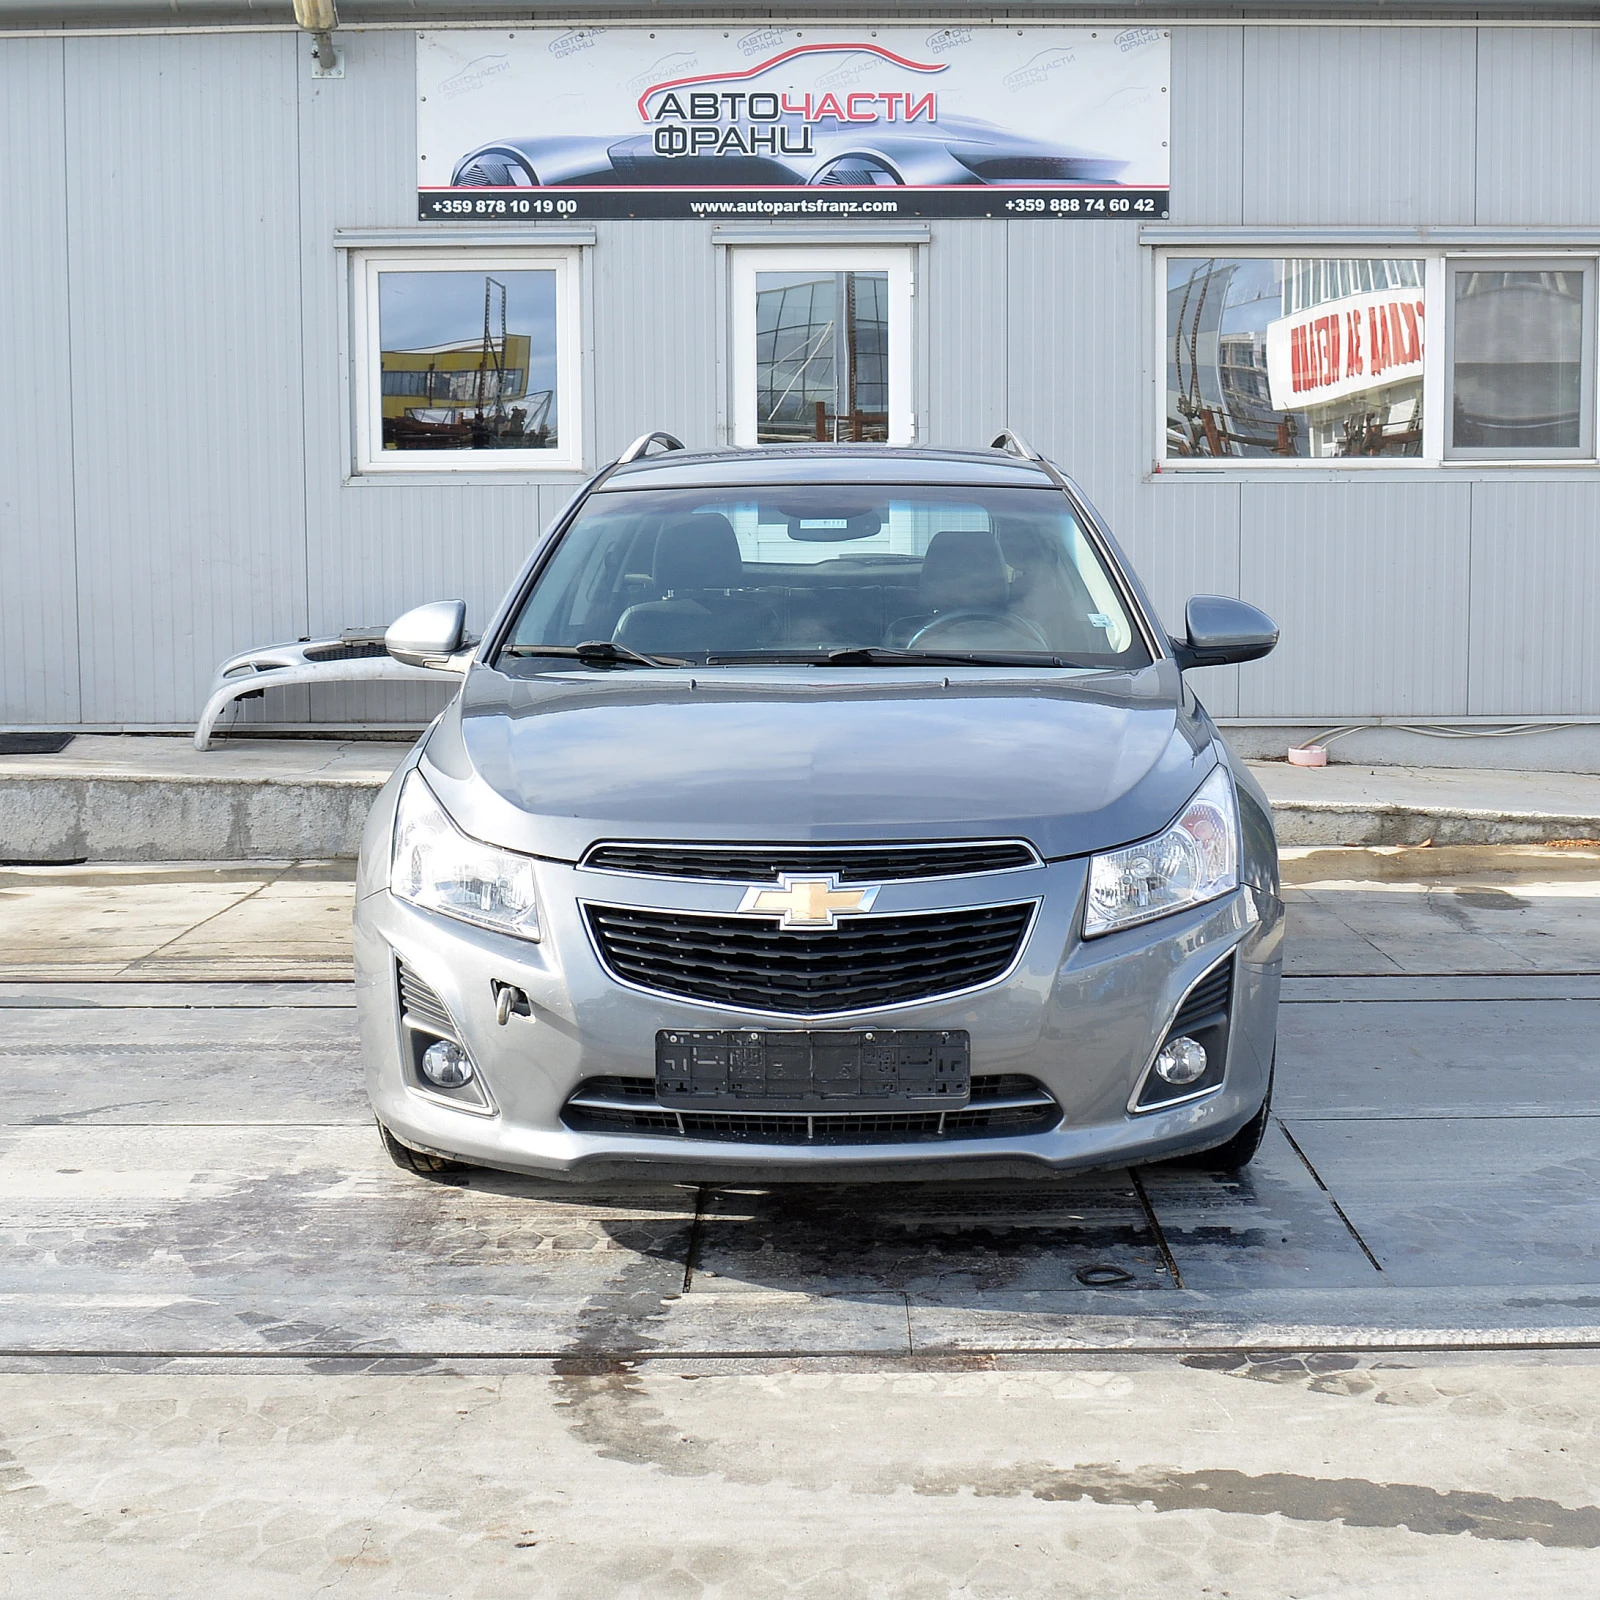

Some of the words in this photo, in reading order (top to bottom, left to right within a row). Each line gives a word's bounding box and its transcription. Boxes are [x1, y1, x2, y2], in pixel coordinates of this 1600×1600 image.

[654, 92, 935, 120] АВТОЧАСТИ
[654, 124, 814, 155] ФРАНЦ
[432, 199, 473, 213] +359
[475, 199, 506, 213] 878
[509, 199, 530, 213] 10
[533, 199, 554, 213] 19
[556, 199, 578, 213] 00
[690, 199, 898, 215] www.autopartsfranz.com
[1005, 198, 1046, 212] +359
[1049, 198, 1080, 212] 888
[1084, 198, 1105, 212] 74
[1109, 198, 1130, 212] 60
[1133, 198, 1155, 212] 42
